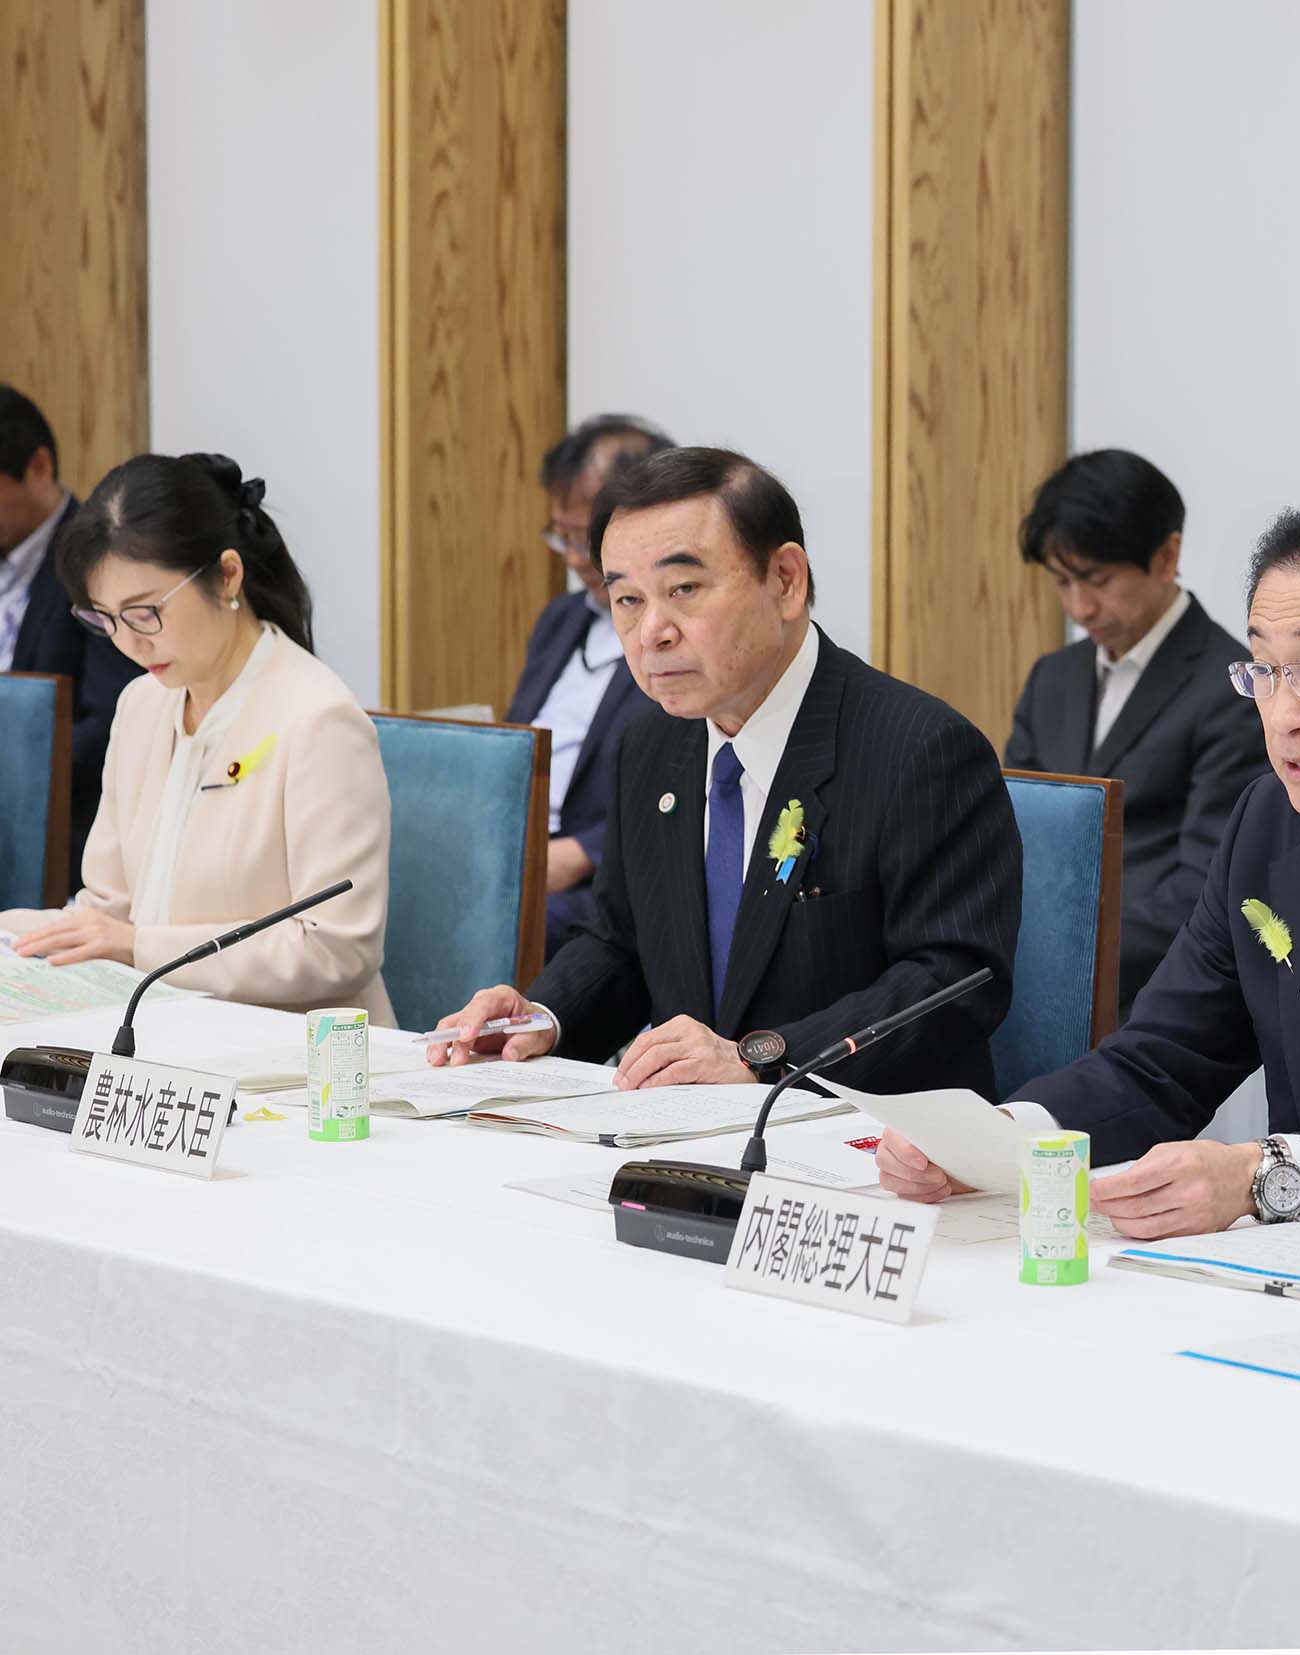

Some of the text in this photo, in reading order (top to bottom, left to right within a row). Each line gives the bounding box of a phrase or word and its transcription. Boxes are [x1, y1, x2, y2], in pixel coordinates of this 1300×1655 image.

[82, 1069, 221, 1158] 農林水産大臣
[736, 1194, 915, 1301] 内閣総理大臣
